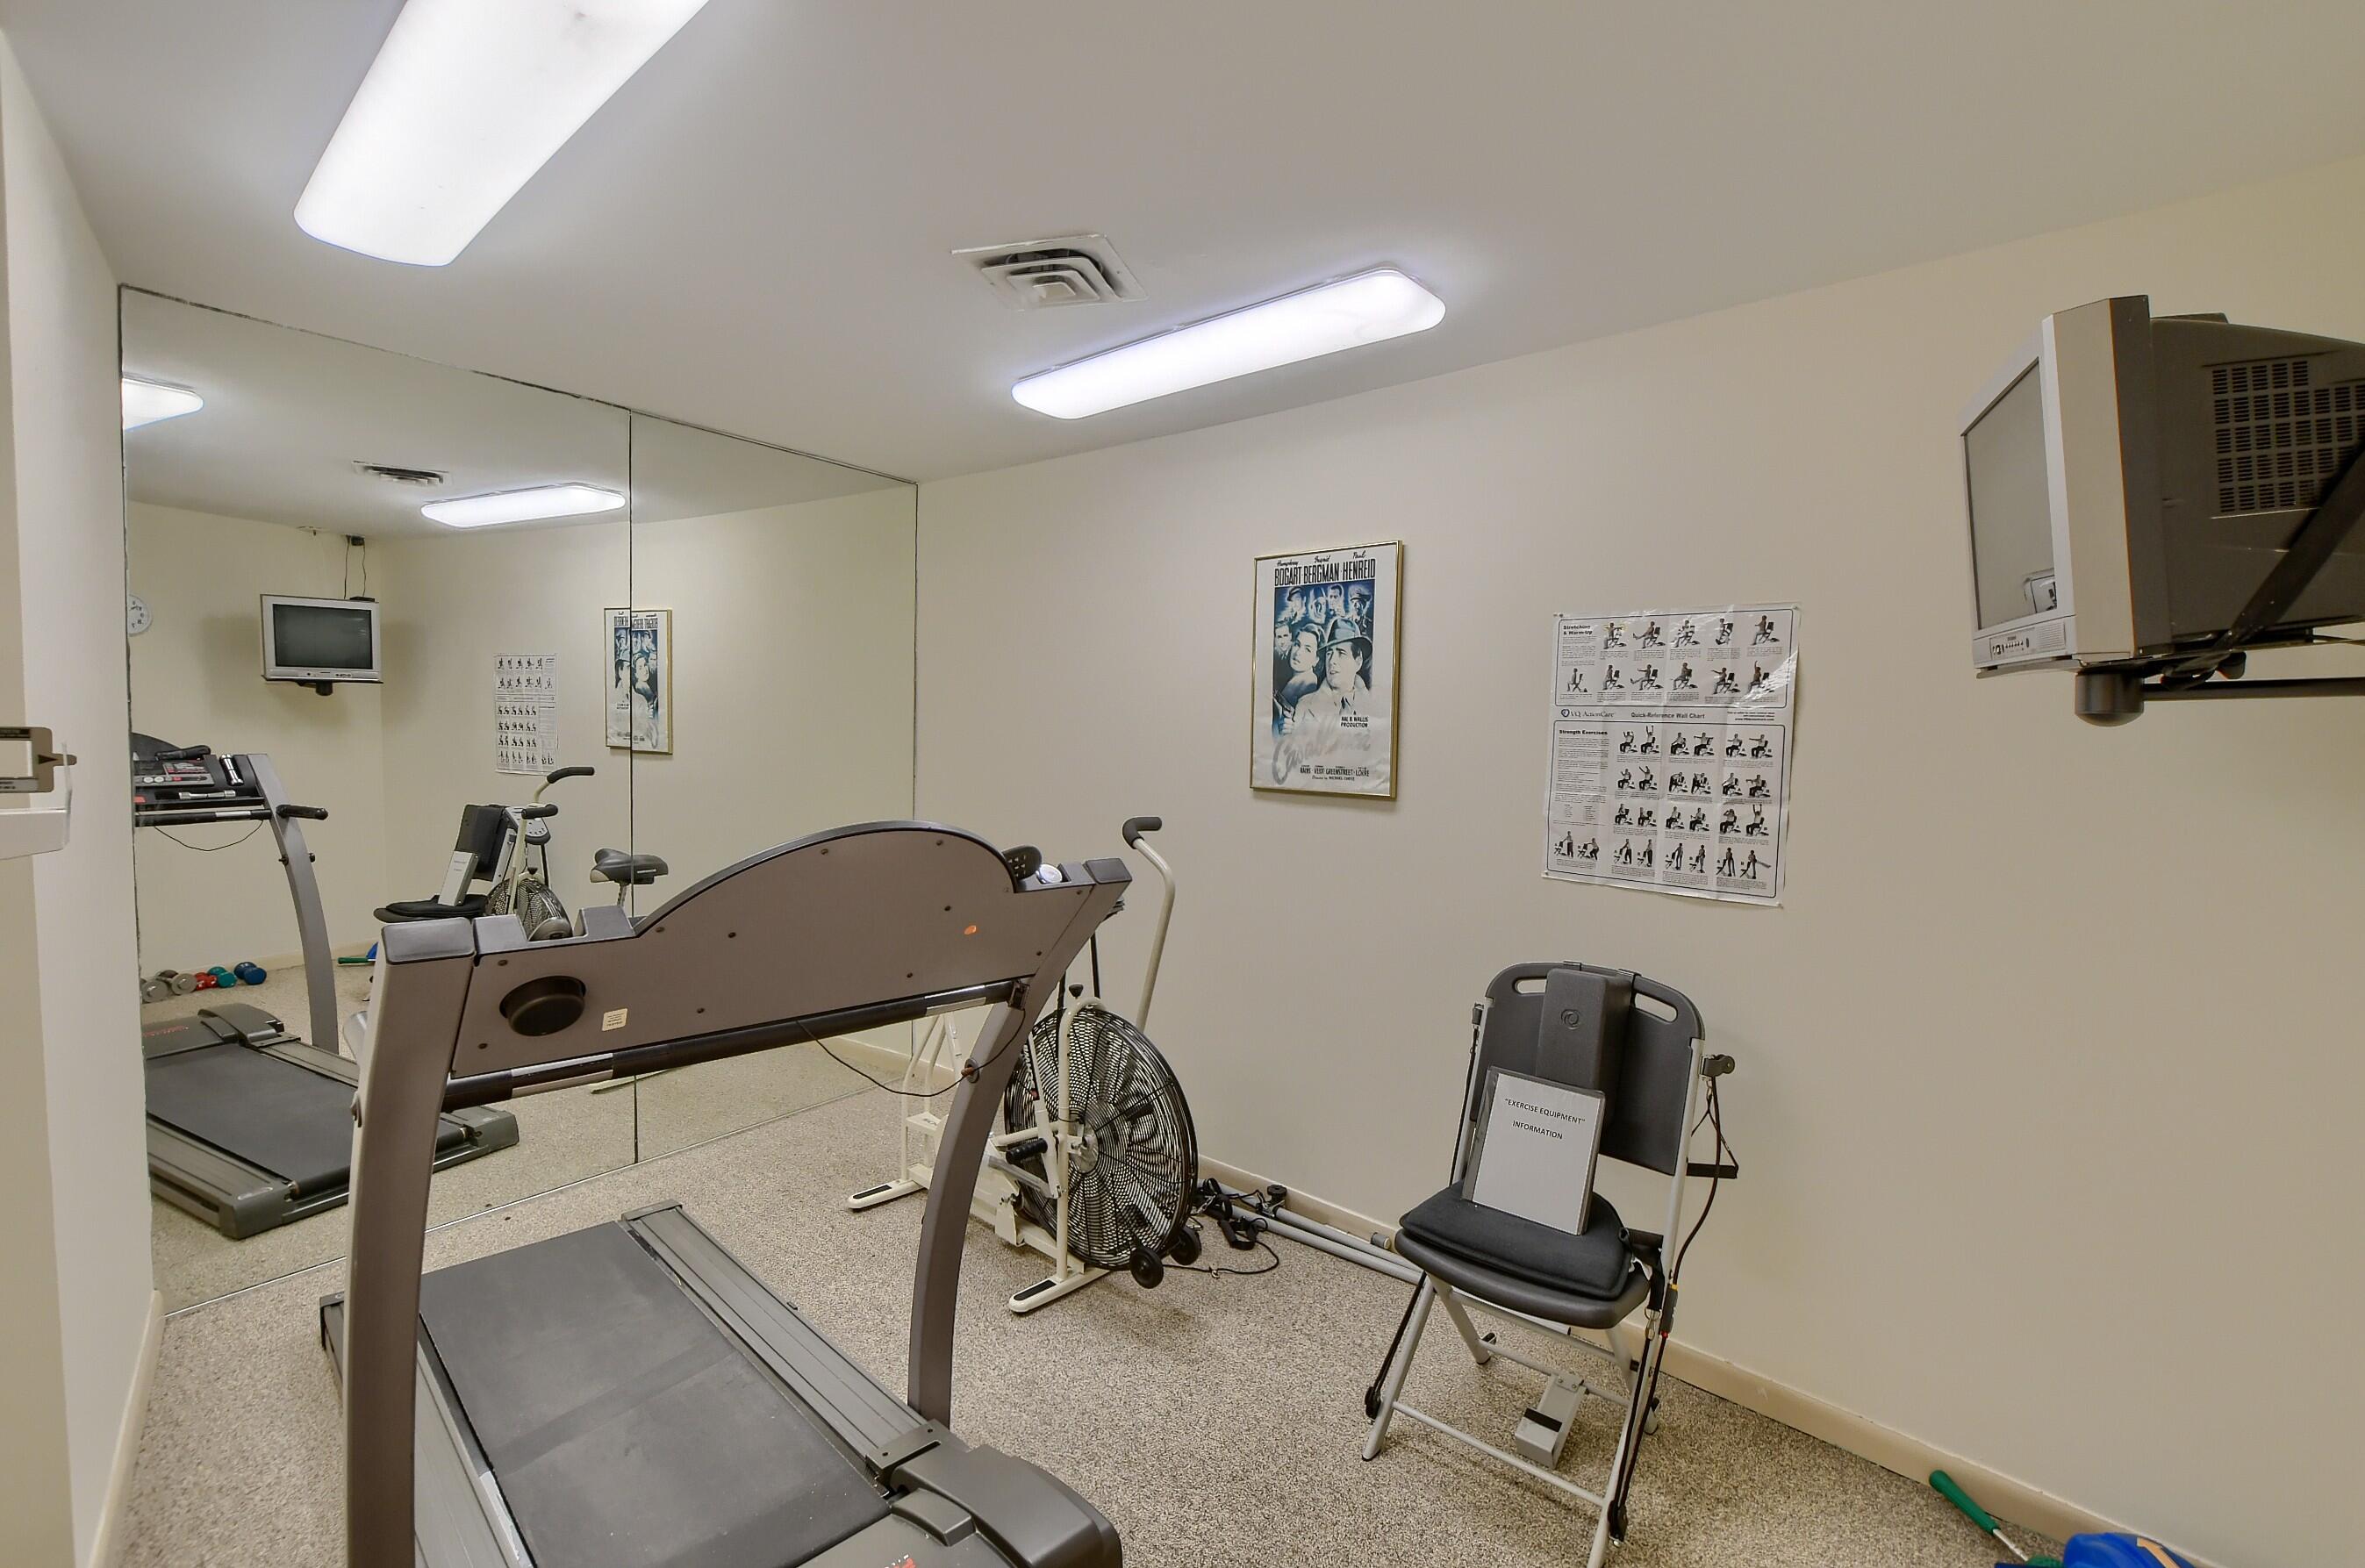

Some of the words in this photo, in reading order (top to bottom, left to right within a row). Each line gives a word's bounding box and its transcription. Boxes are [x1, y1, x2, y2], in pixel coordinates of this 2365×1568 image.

[1274, 566, 1302, 586] BOGART
[1303, 562, 1339, 584] BERGMAN
[1343, 558, 1376, 580] HENREID
[1512, 1121, 1563, 1140] INFORMATION
